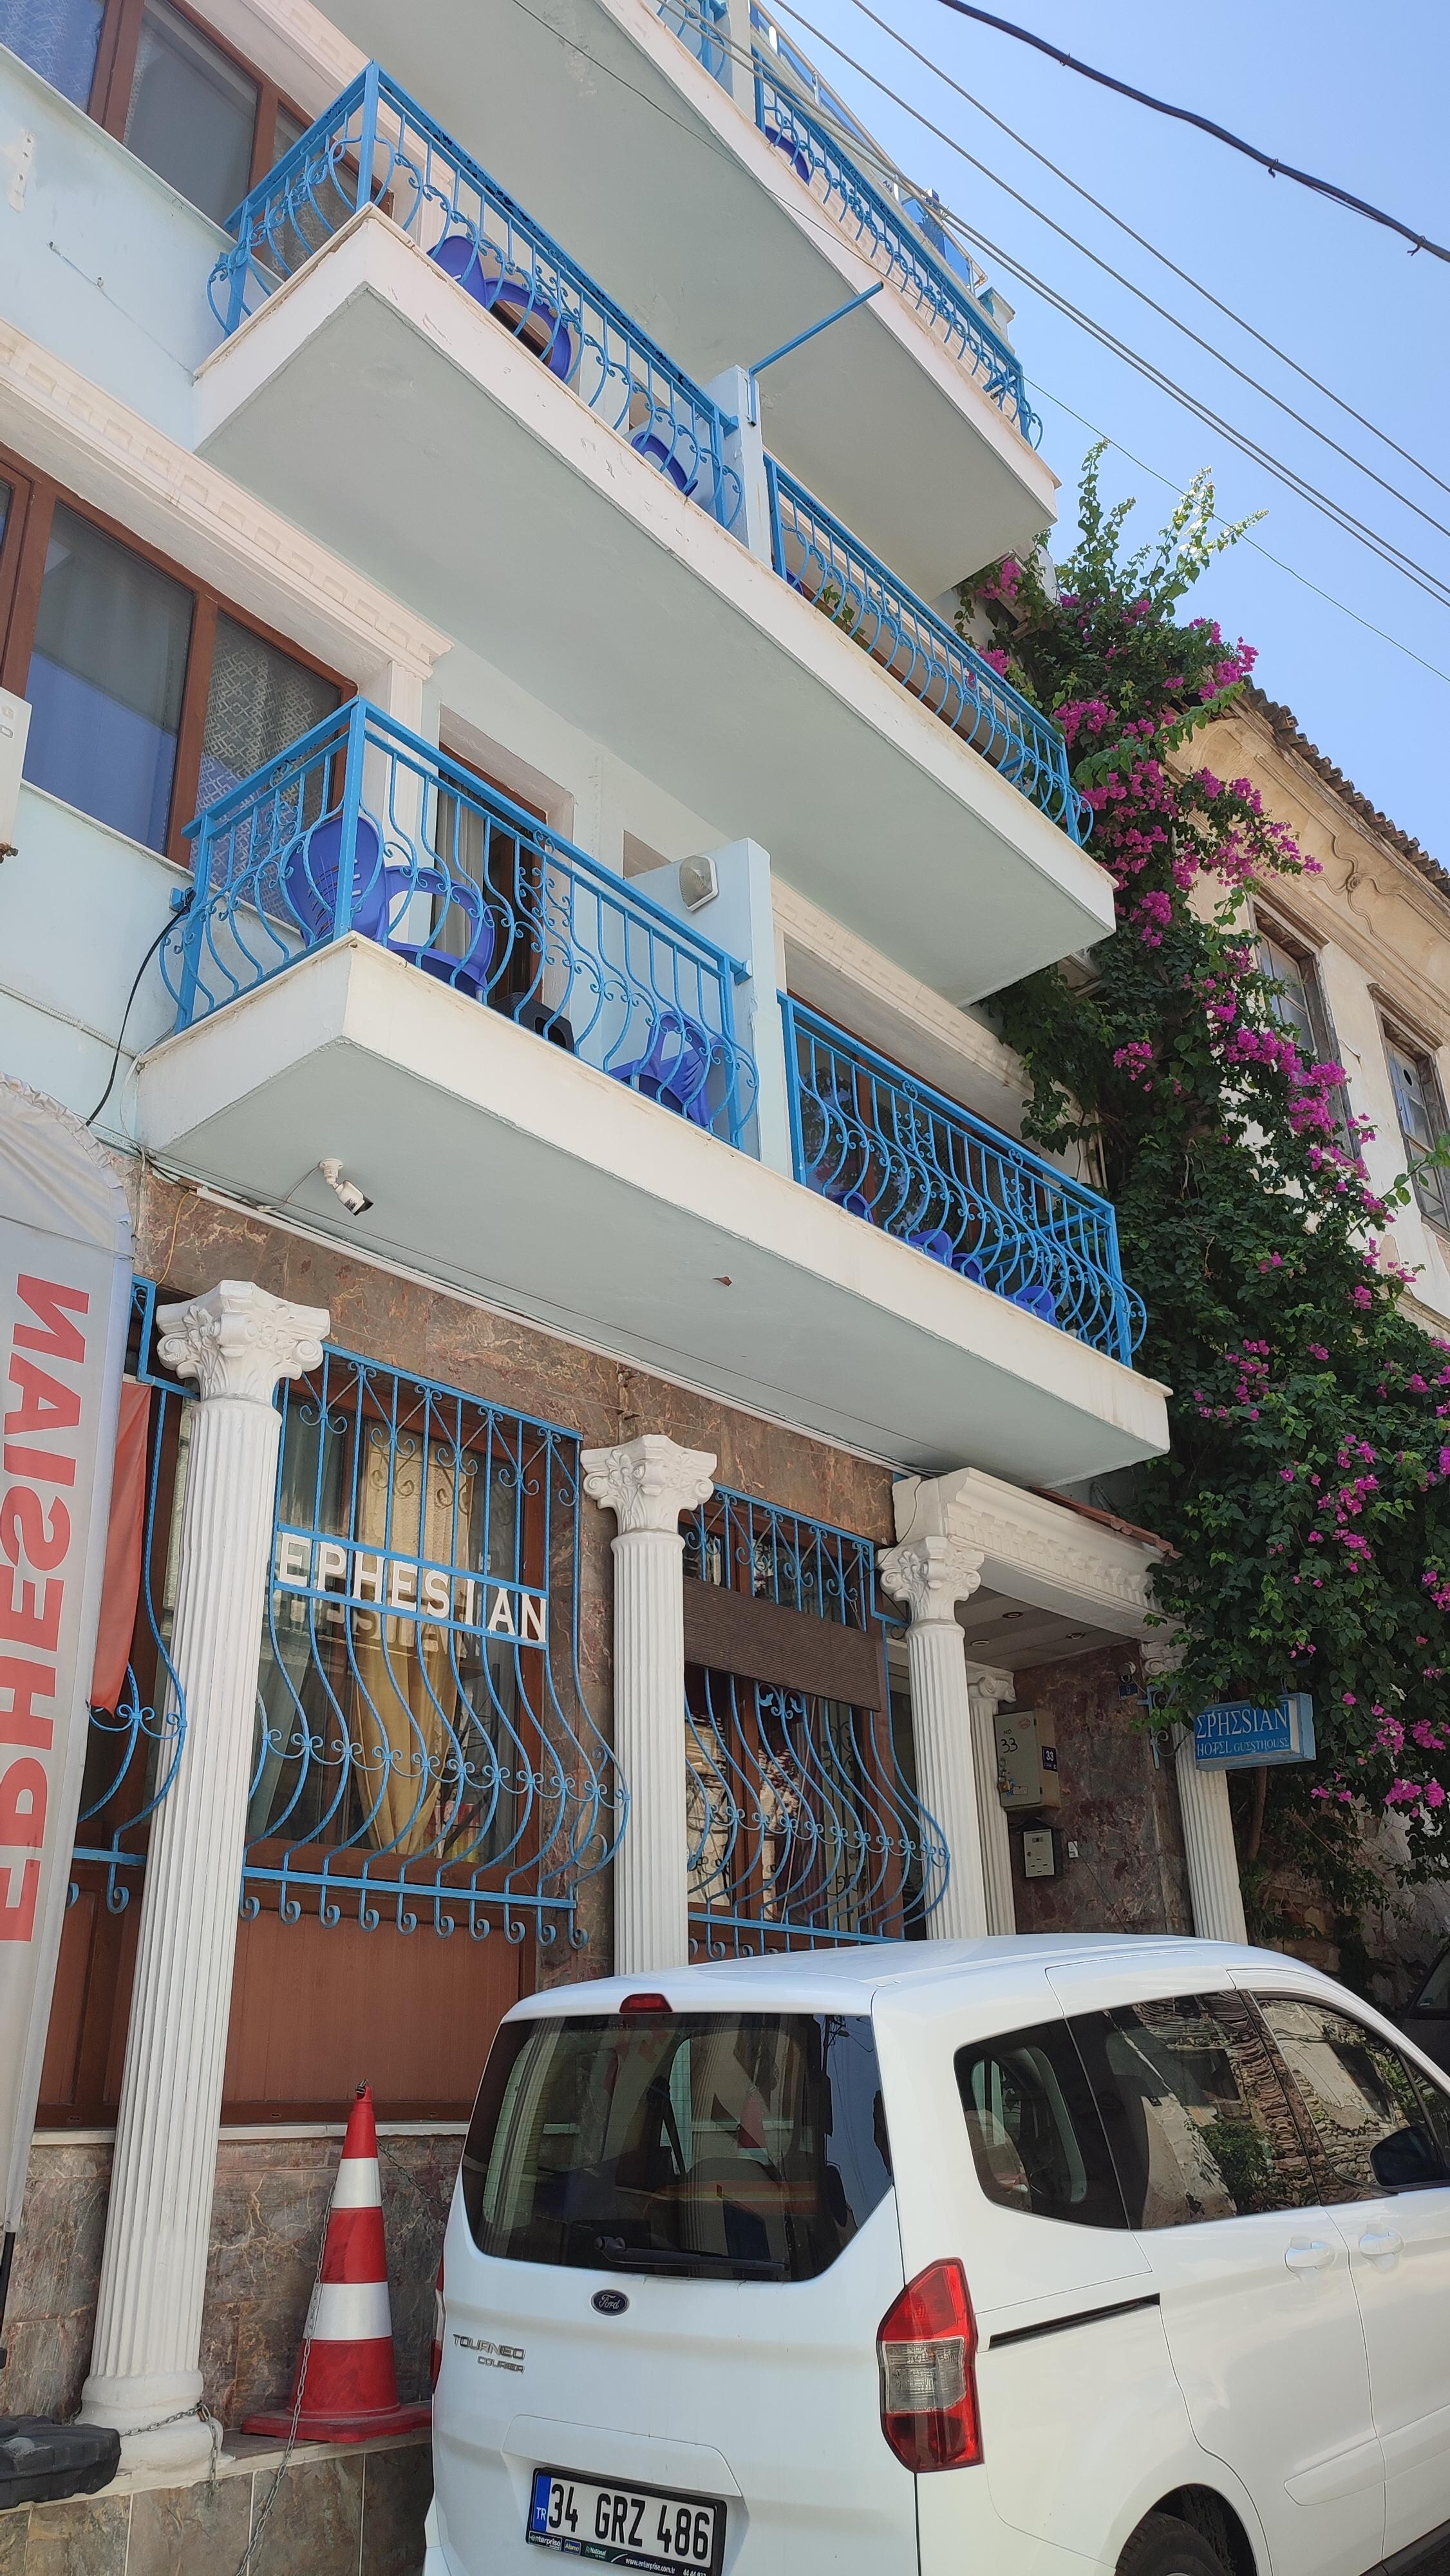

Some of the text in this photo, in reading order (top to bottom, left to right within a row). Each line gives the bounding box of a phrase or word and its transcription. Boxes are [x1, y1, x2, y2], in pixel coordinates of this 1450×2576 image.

[278, 1533, 547, 1642] EPHESIAN
[1001, 1738, 1018, 1754] 33
[1196, 1737, 1288, 1756] HOTEL GUESTHOUSE
[1046, 1750, 1054, 1761] 33
[599, 2294, 621, 2309] Ford
[453, 2333, 526, 2360] TOURNEO
[477, 2356, 525, 2374] COURIER
[536, 2506, 546, 2521] TR
[549, 2484, 710, 2560] 34 GRZ 486
[531, 2535, 561, 2547] enterprise
[625, 2558, 675, 2574] www.enterprise.com.tr
